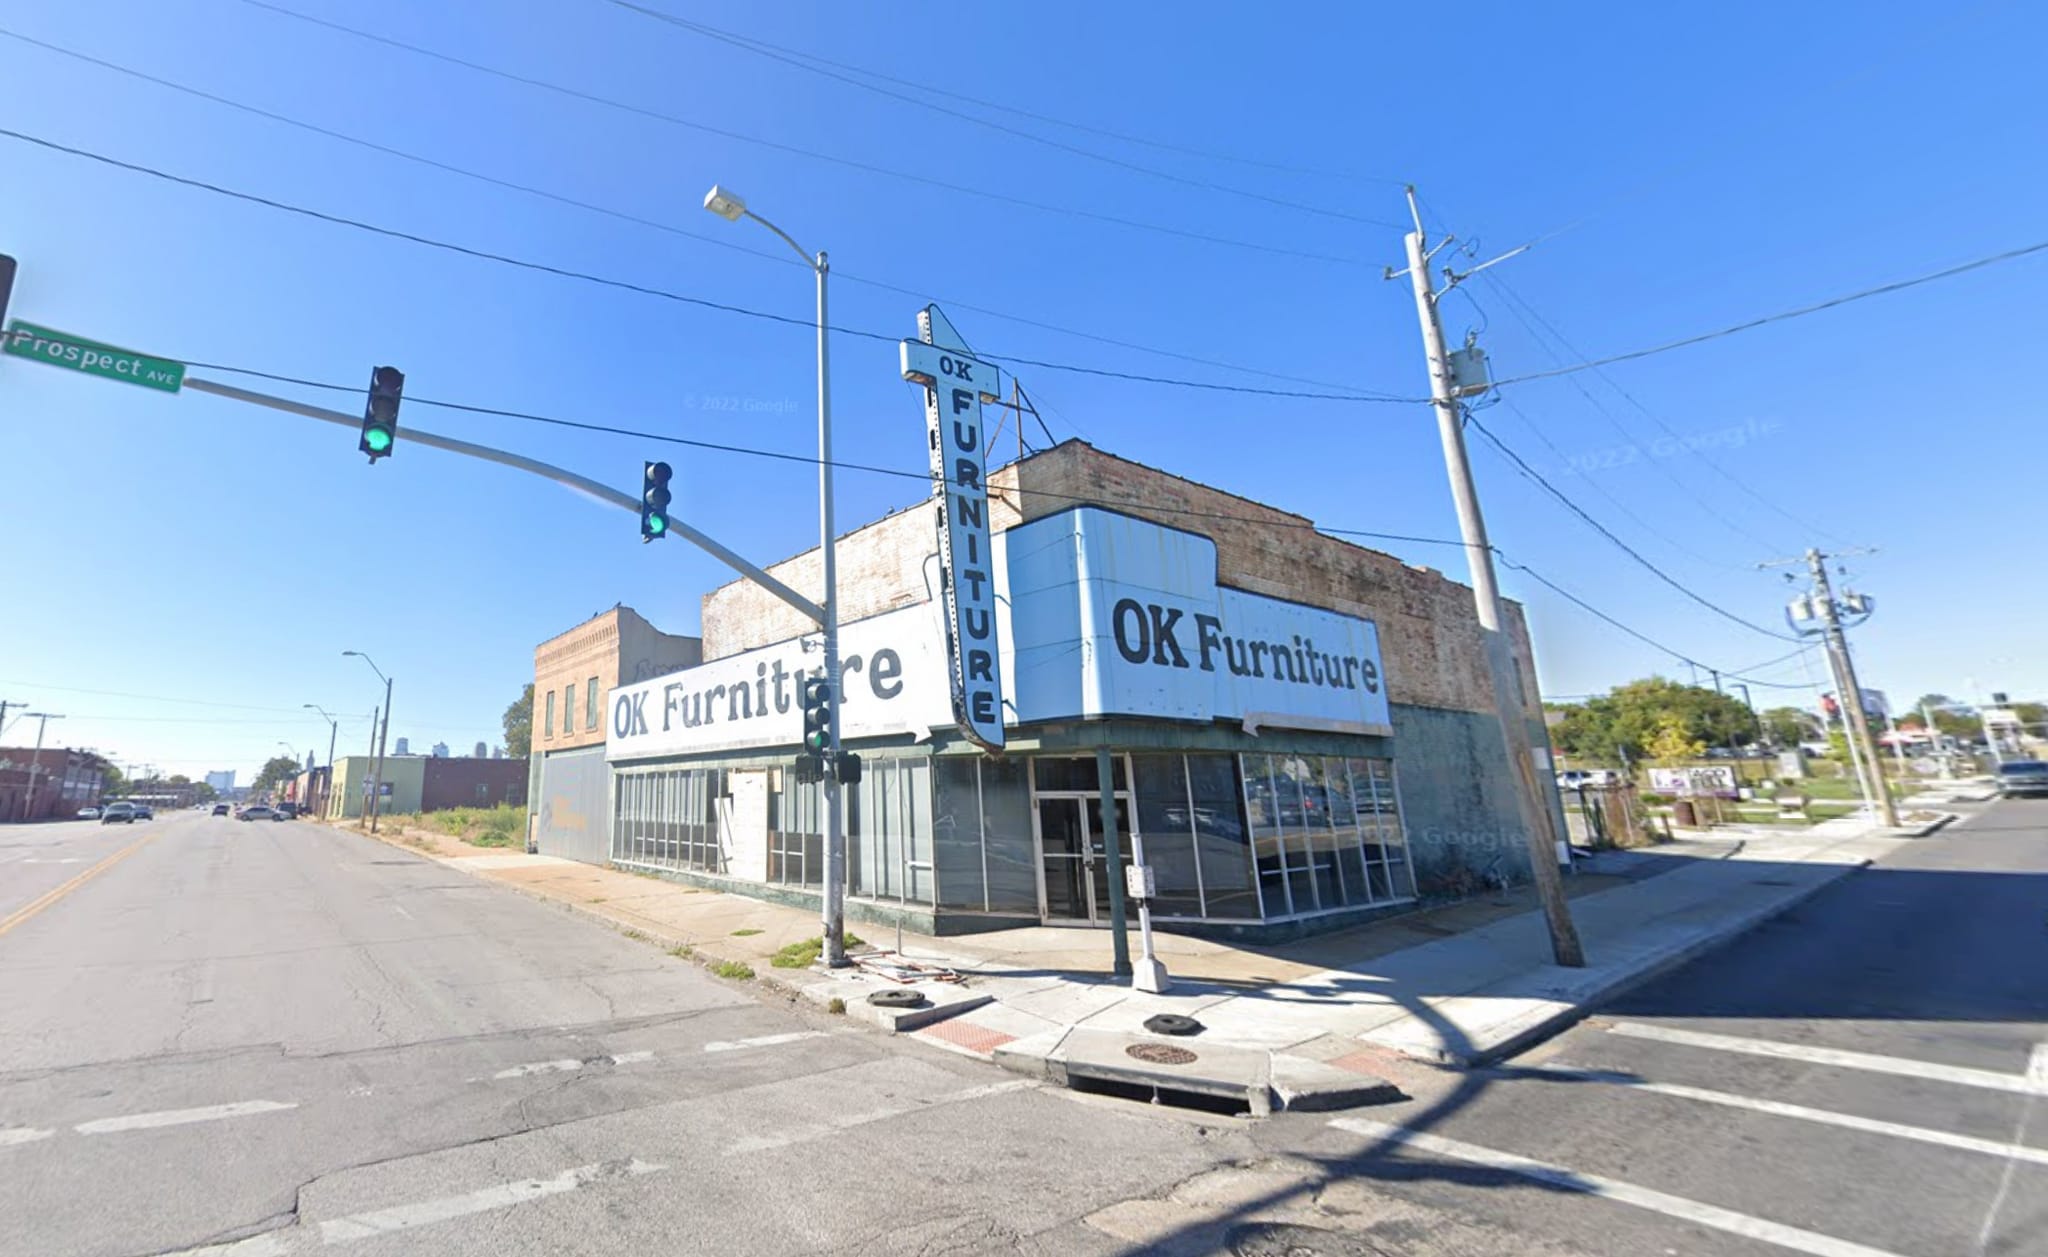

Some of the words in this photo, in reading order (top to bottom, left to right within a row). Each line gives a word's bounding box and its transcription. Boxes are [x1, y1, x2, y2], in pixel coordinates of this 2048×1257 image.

[12, 329, 142, 376] Prospect
[147, 371, 175, 385] AVE
[939, 355, 973, 383] OK
[952, 388, 996, 725] FURNITURE
[1113, 598, 1190, 669] OK
[1194, 613, 1378, 695] Furniture
[615, 689, 649, 740] OK
